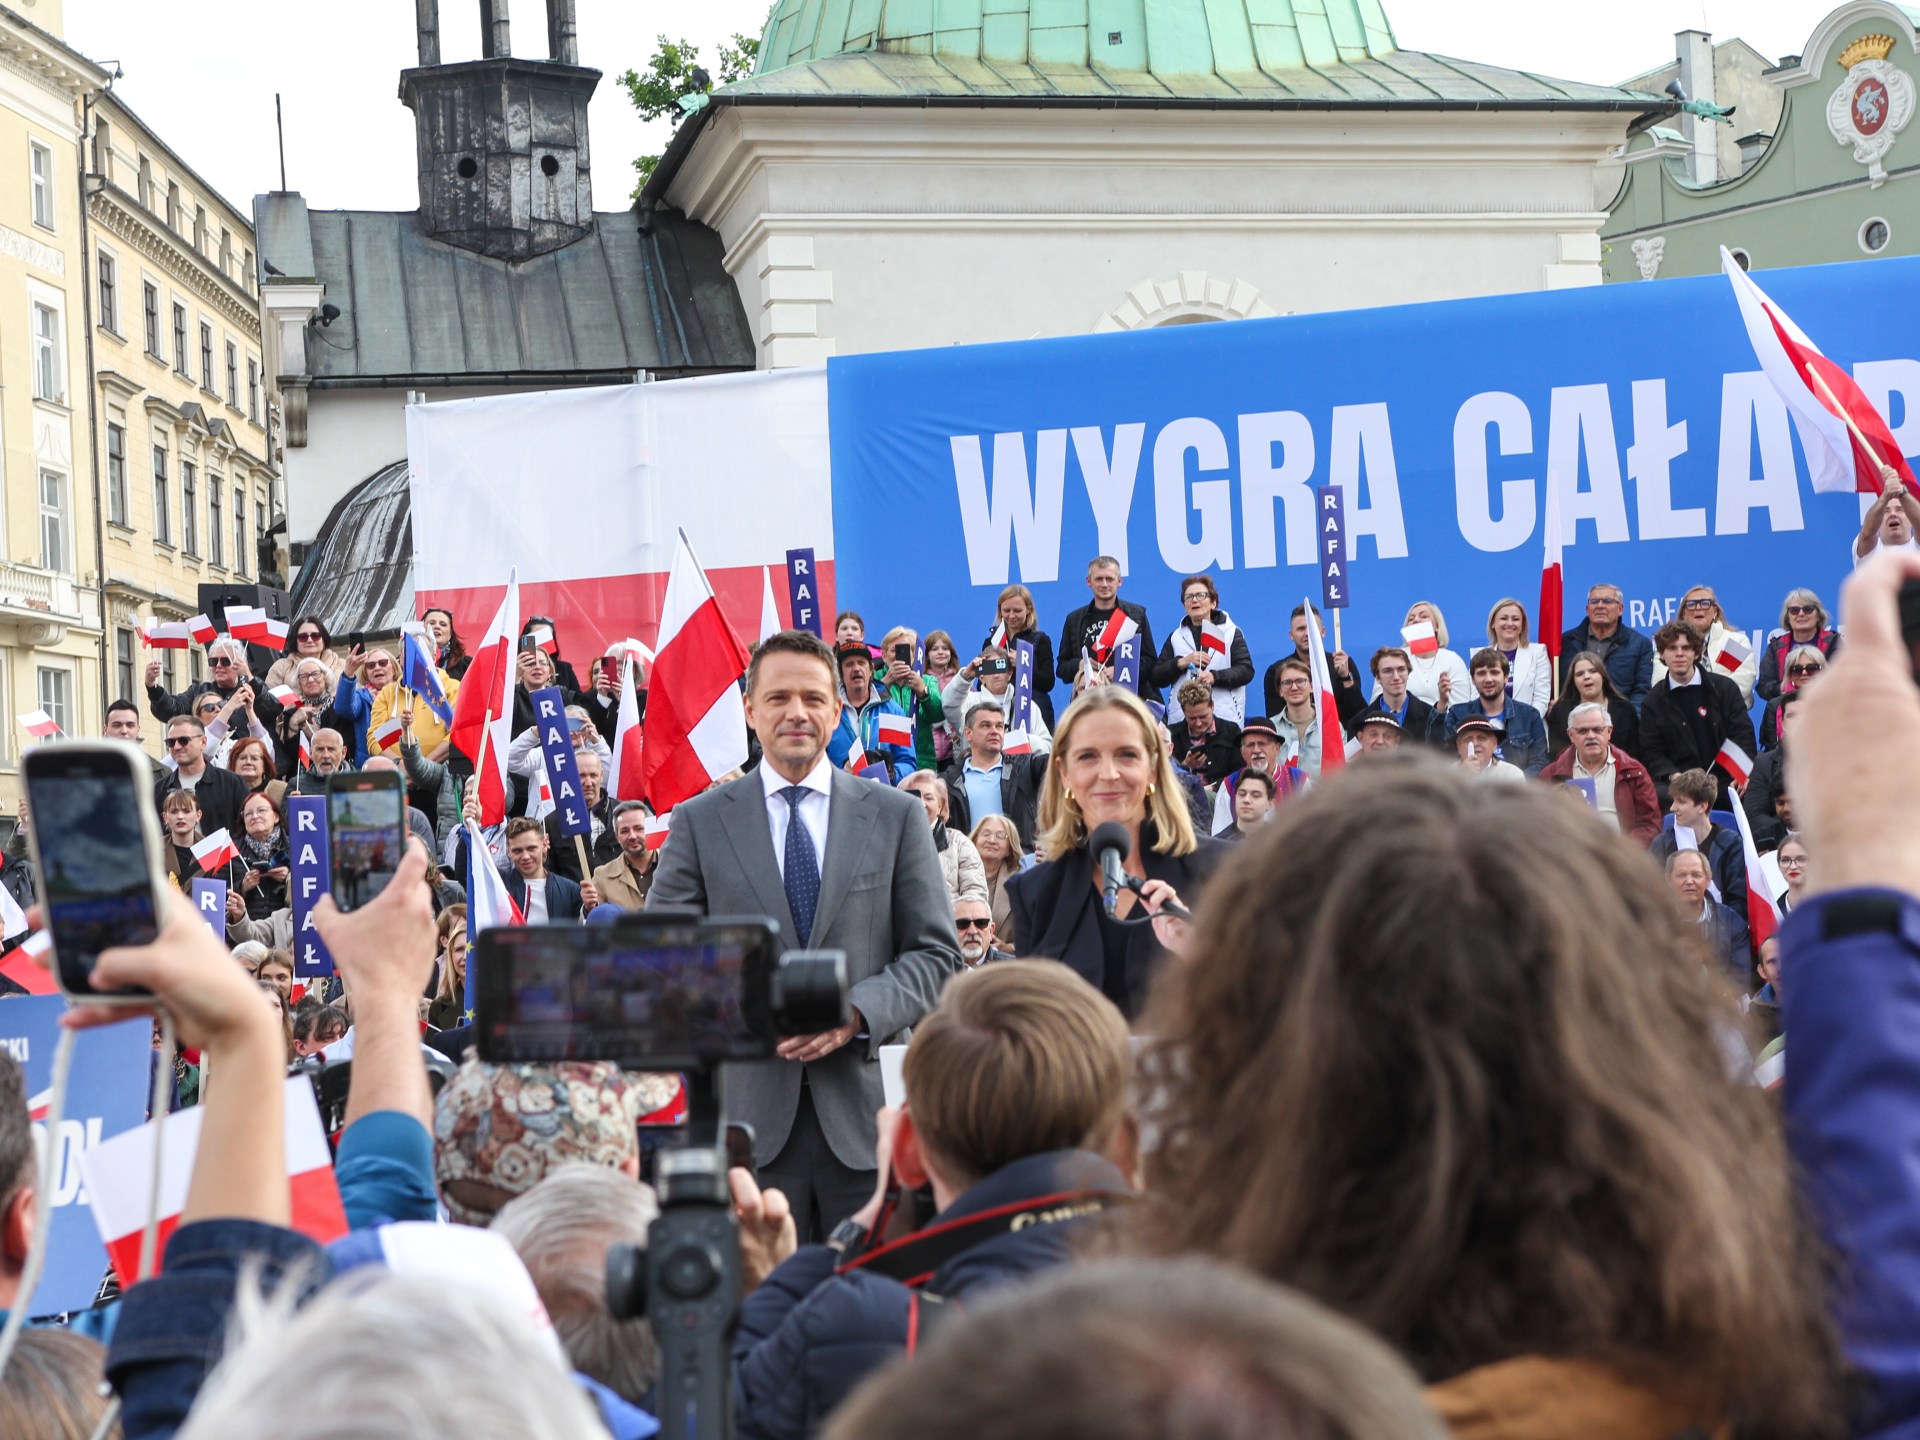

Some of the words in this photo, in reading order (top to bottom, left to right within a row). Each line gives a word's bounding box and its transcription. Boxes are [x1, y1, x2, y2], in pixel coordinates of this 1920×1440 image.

[950, 402, 1409, 586] WYGRA
[1453, 370, 1804, 552] CAŁA
[794, 559, 811, 625] RAF
[1324, 494, 1341, 600] RAFAŁ
[1630, 597, 1684, 628] RAF
[1020, 650, 1029, 732] RAFA
[539, 700, 581, 827] RAFAŁ
[298, 811, 320, 965] RAFAŁ
